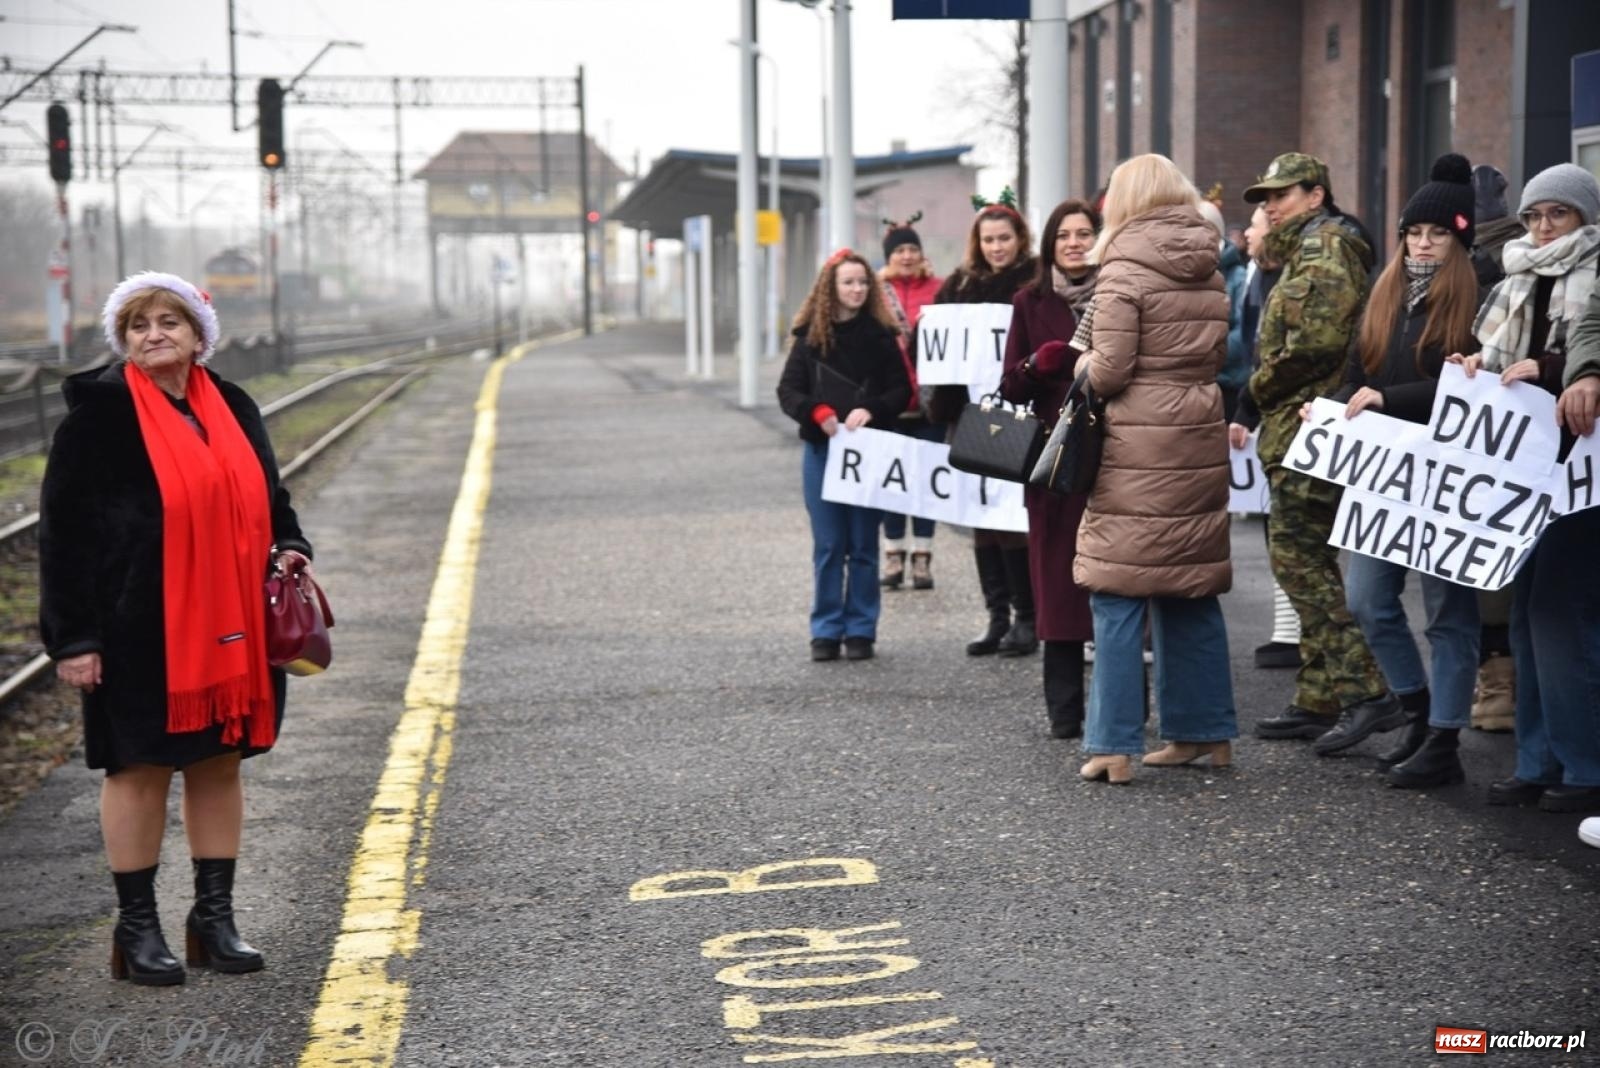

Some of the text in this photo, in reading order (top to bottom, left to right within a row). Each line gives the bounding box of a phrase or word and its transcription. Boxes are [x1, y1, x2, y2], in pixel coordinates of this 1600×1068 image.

[922, 327, 1006, 362] WIT
[1432, 394, 1532, 462] DNI
[628, 857, 880, 903] B
